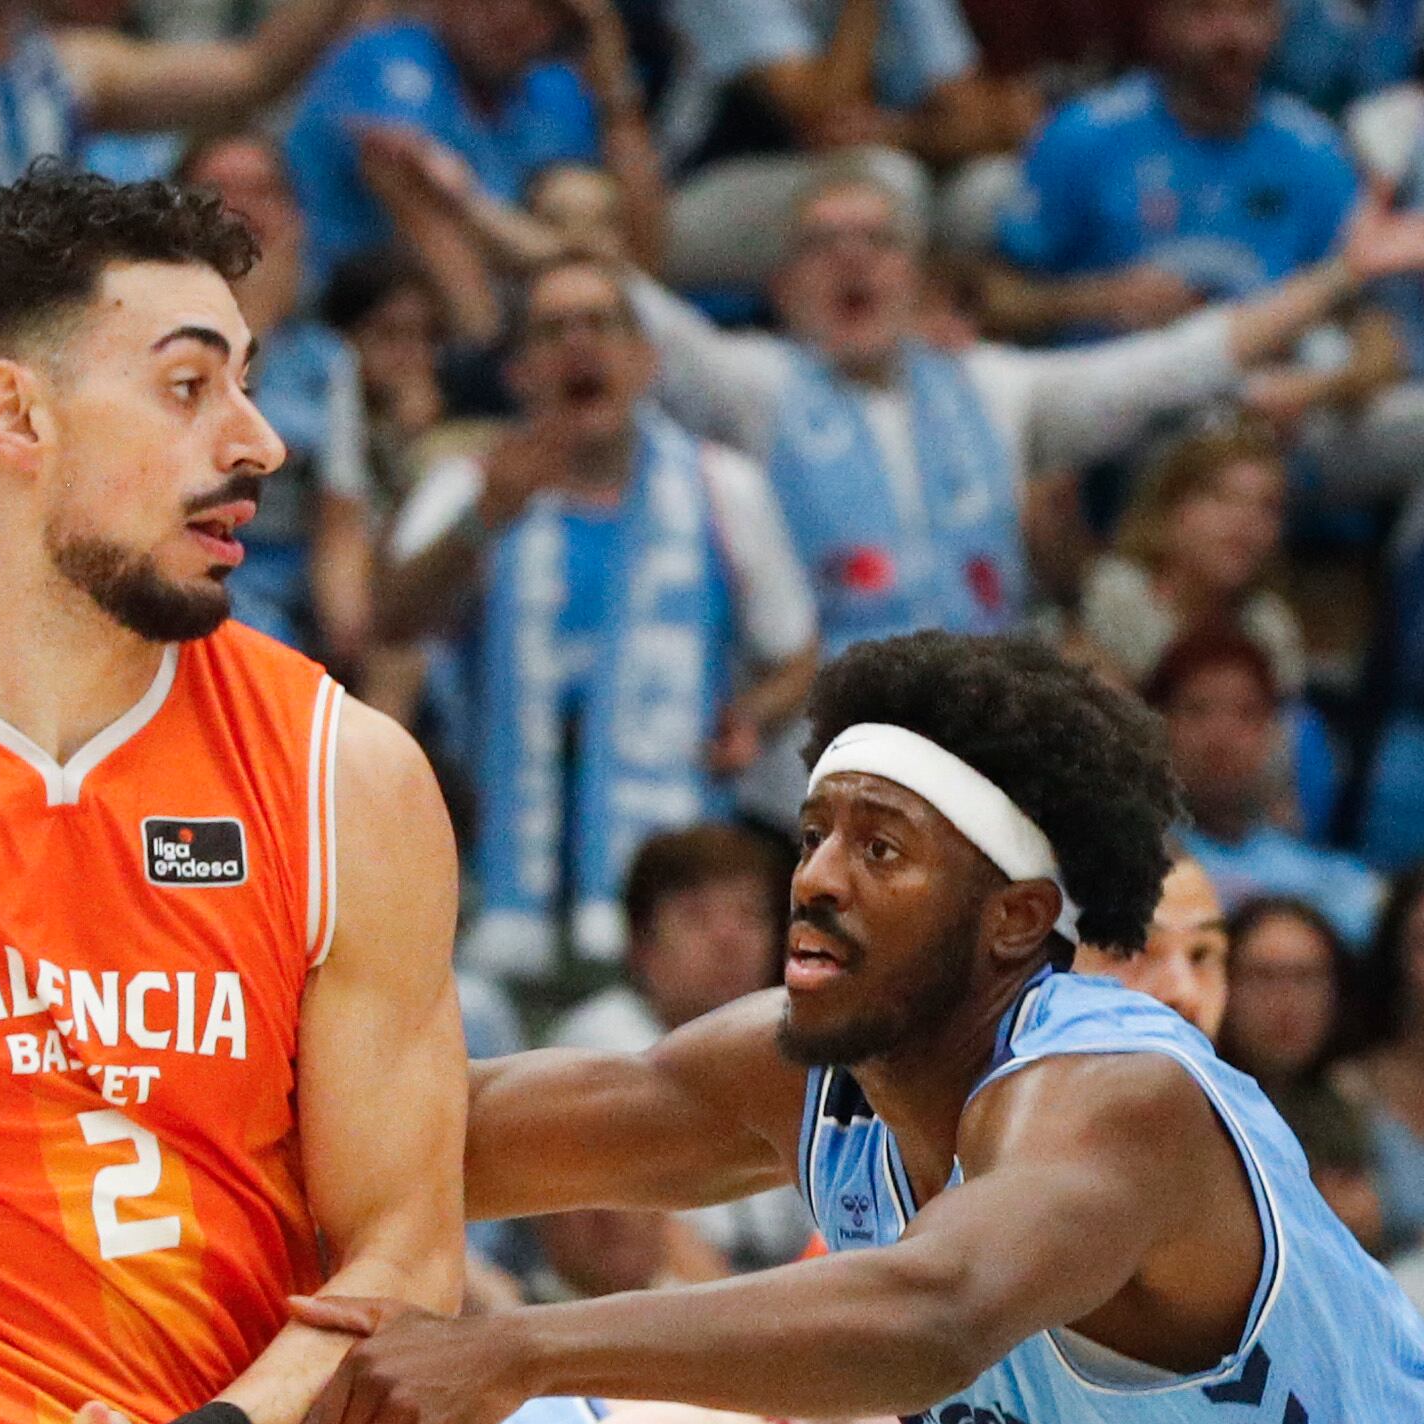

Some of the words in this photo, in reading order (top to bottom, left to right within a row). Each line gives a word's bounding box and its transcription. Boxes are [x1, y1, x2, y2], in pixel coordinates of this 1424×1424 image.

[153, 834, 191, 860] liga
[154, 857, 239, 878] endesa
[4, 1029, 162, 1107] BAET
[77, 1107, 181, 1261] 2
